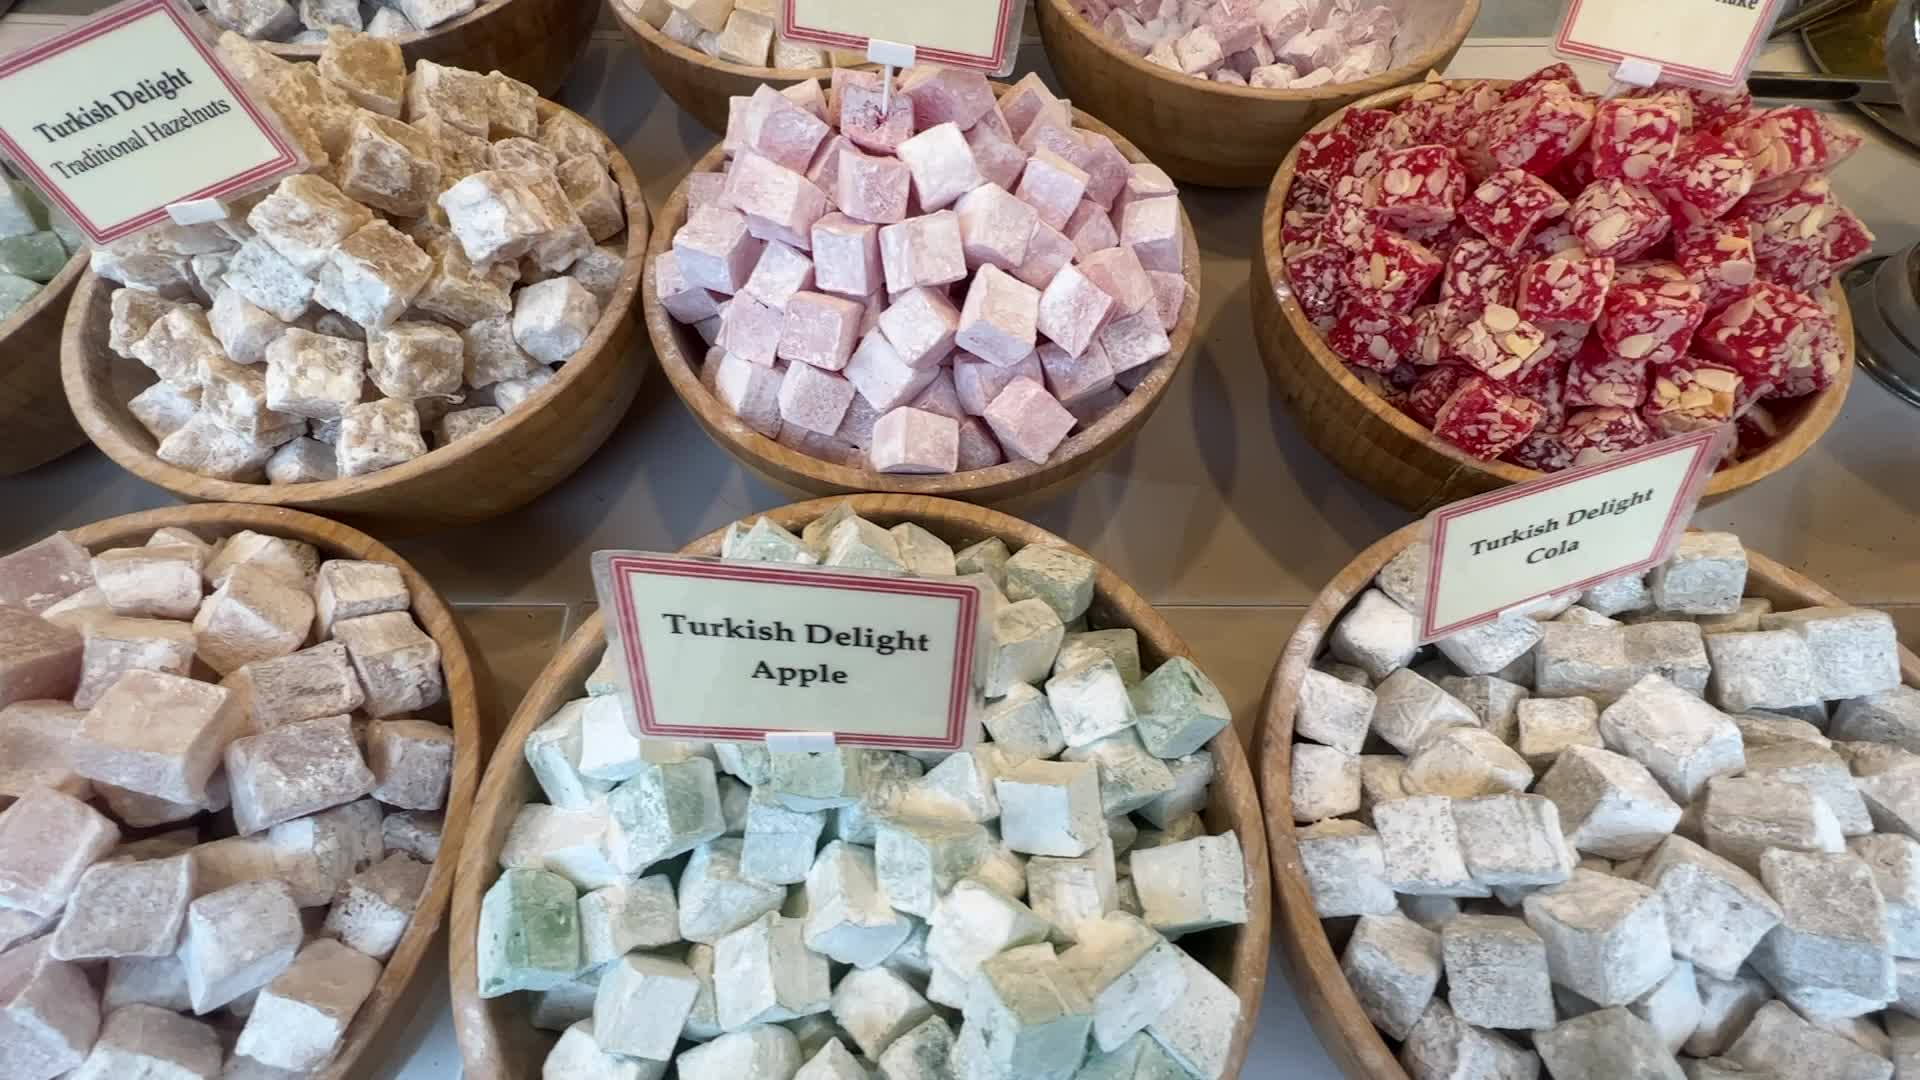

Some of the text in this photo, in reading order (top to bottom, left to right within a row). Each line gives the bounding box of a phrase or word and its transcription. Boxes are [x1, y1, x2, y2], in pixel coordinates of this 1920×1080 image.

[33, 67, 193, 143] Turkish Delight
[51, 98, 232, 179] Traditional Hazelnuts
[1470, 488, 1654, 555] Turkish Delight
[1526, 539, 1580, 565] Cola
[662, 613, 930, 655] Turkish Delight
[751, 659, 848, 687] Apple
